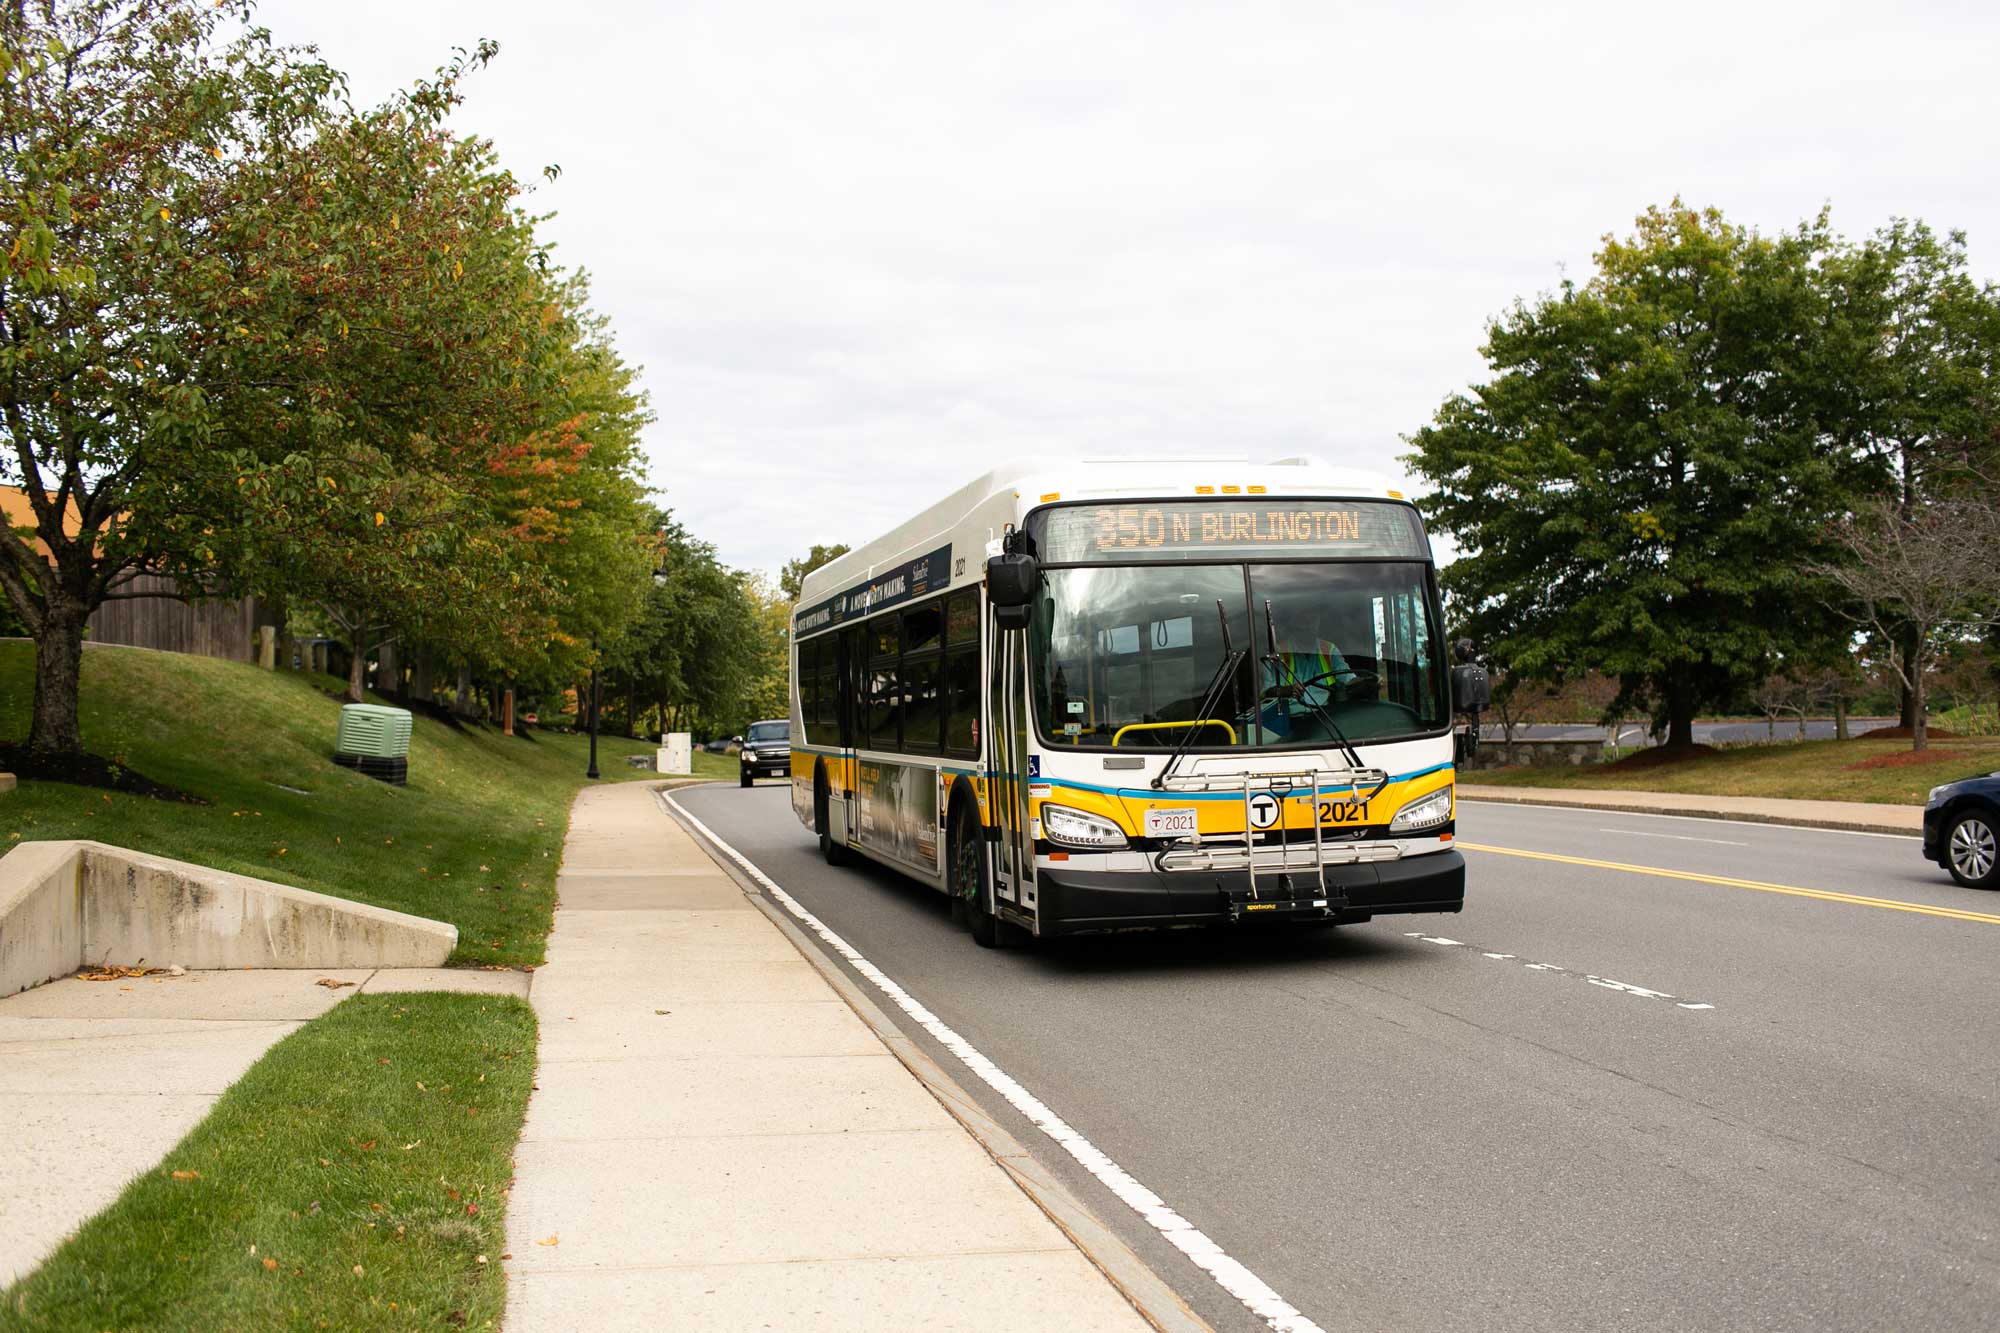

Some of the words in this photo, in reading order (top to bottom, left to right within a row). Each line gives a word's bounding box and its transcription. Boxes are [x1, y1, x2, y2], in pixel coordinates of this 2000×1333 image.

[1095, 509, 1165, 549] 350
[1173, 512, 1191, 542] N
[1202, 510, 1360, 542] BURLINGTON
[955, 556, 966, 578] 2021
[1165, 815, 1195, 830] 2021
[1252, 803, 1273, 823] T
[1319, 801, 1368, 823] 2021
